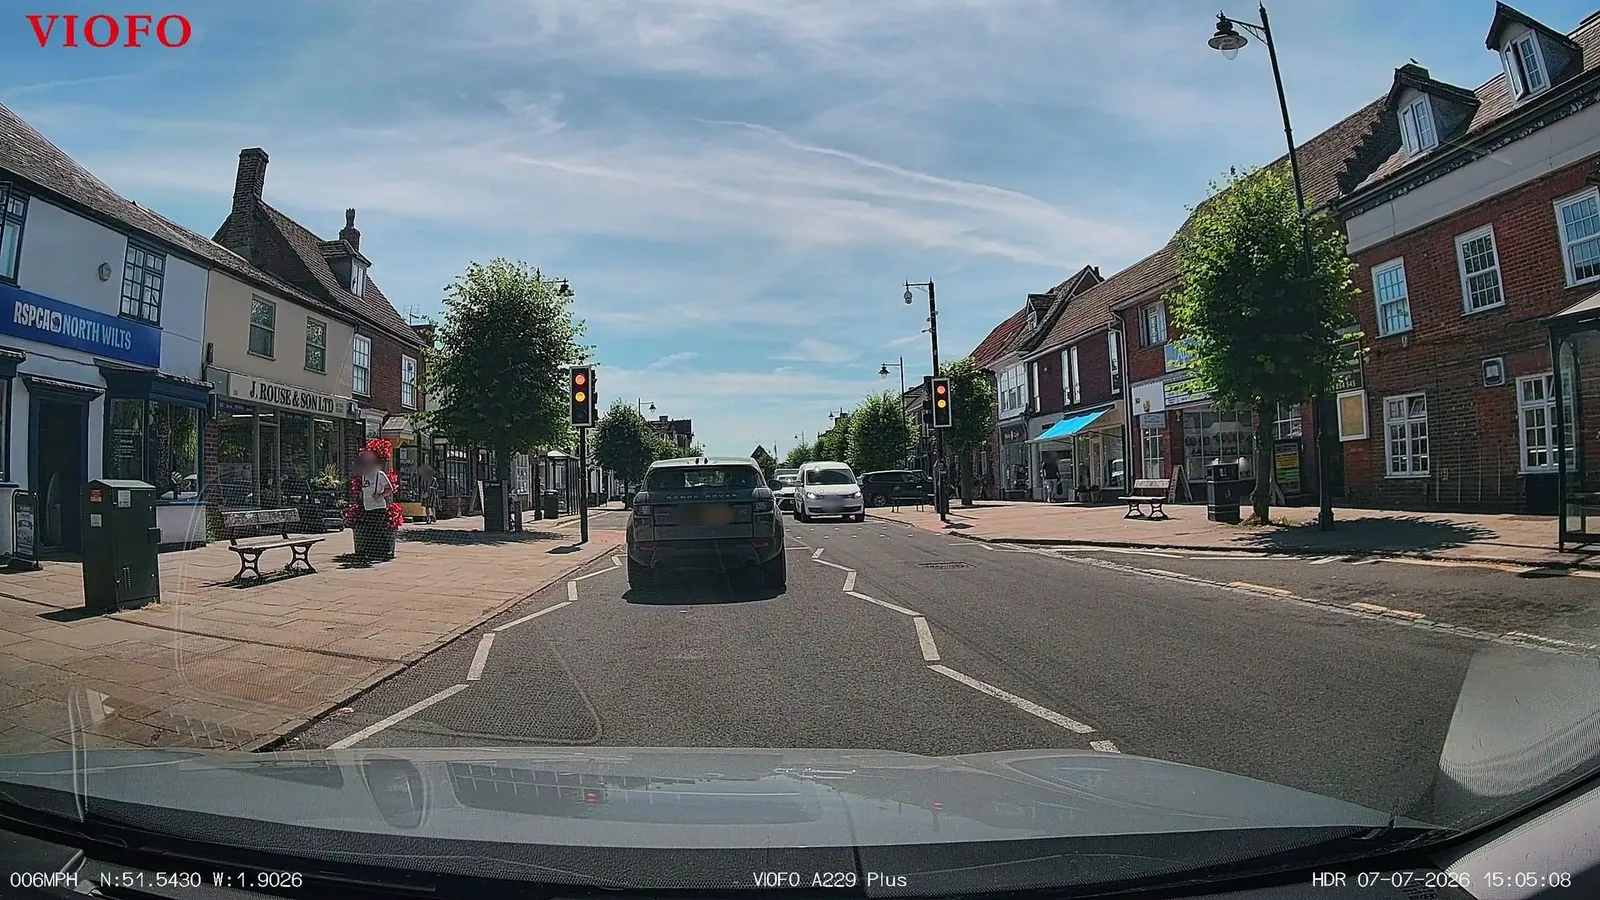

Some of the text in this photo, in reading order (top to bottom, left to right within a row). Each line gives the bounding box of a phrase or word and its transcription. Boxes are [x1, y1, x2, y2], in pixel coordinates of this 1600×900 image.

[13, 301, 132, 350] RSPCA NORTH WILTS
[250, 381, 259, 399] J.
[260, 382, 292, 406] ROUSE
[292, 390, 300, 407] &
[301, 392, 318, 411] SON
[320, 396, 334, 413] LTD
